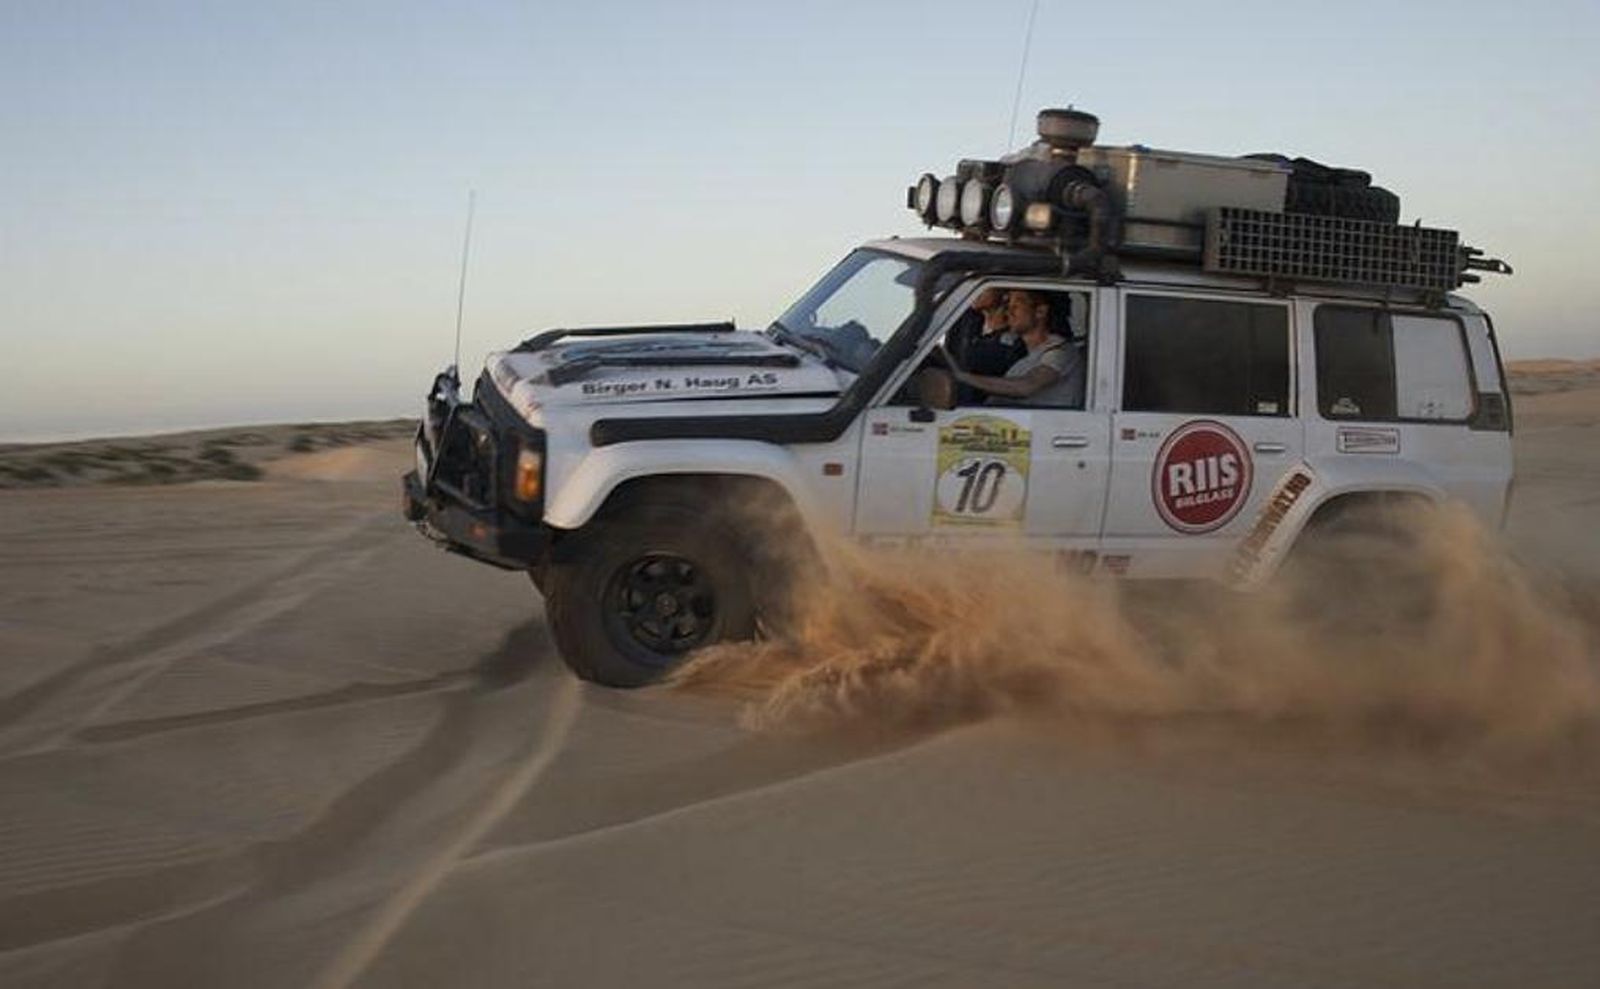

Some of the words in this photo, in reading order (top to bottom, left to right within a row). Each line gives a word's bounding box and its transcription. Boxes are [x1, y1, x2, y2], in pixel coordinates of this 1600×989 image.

[582, 382, 647, 396] Birger
[655, 378, 678, 390] N.
[685, 377, 740, 389] Haug
[747, 373, 778, 386] AS
[956, 460, 1006, 513] 10
[1168, 453, 1238, 497] RIIS
